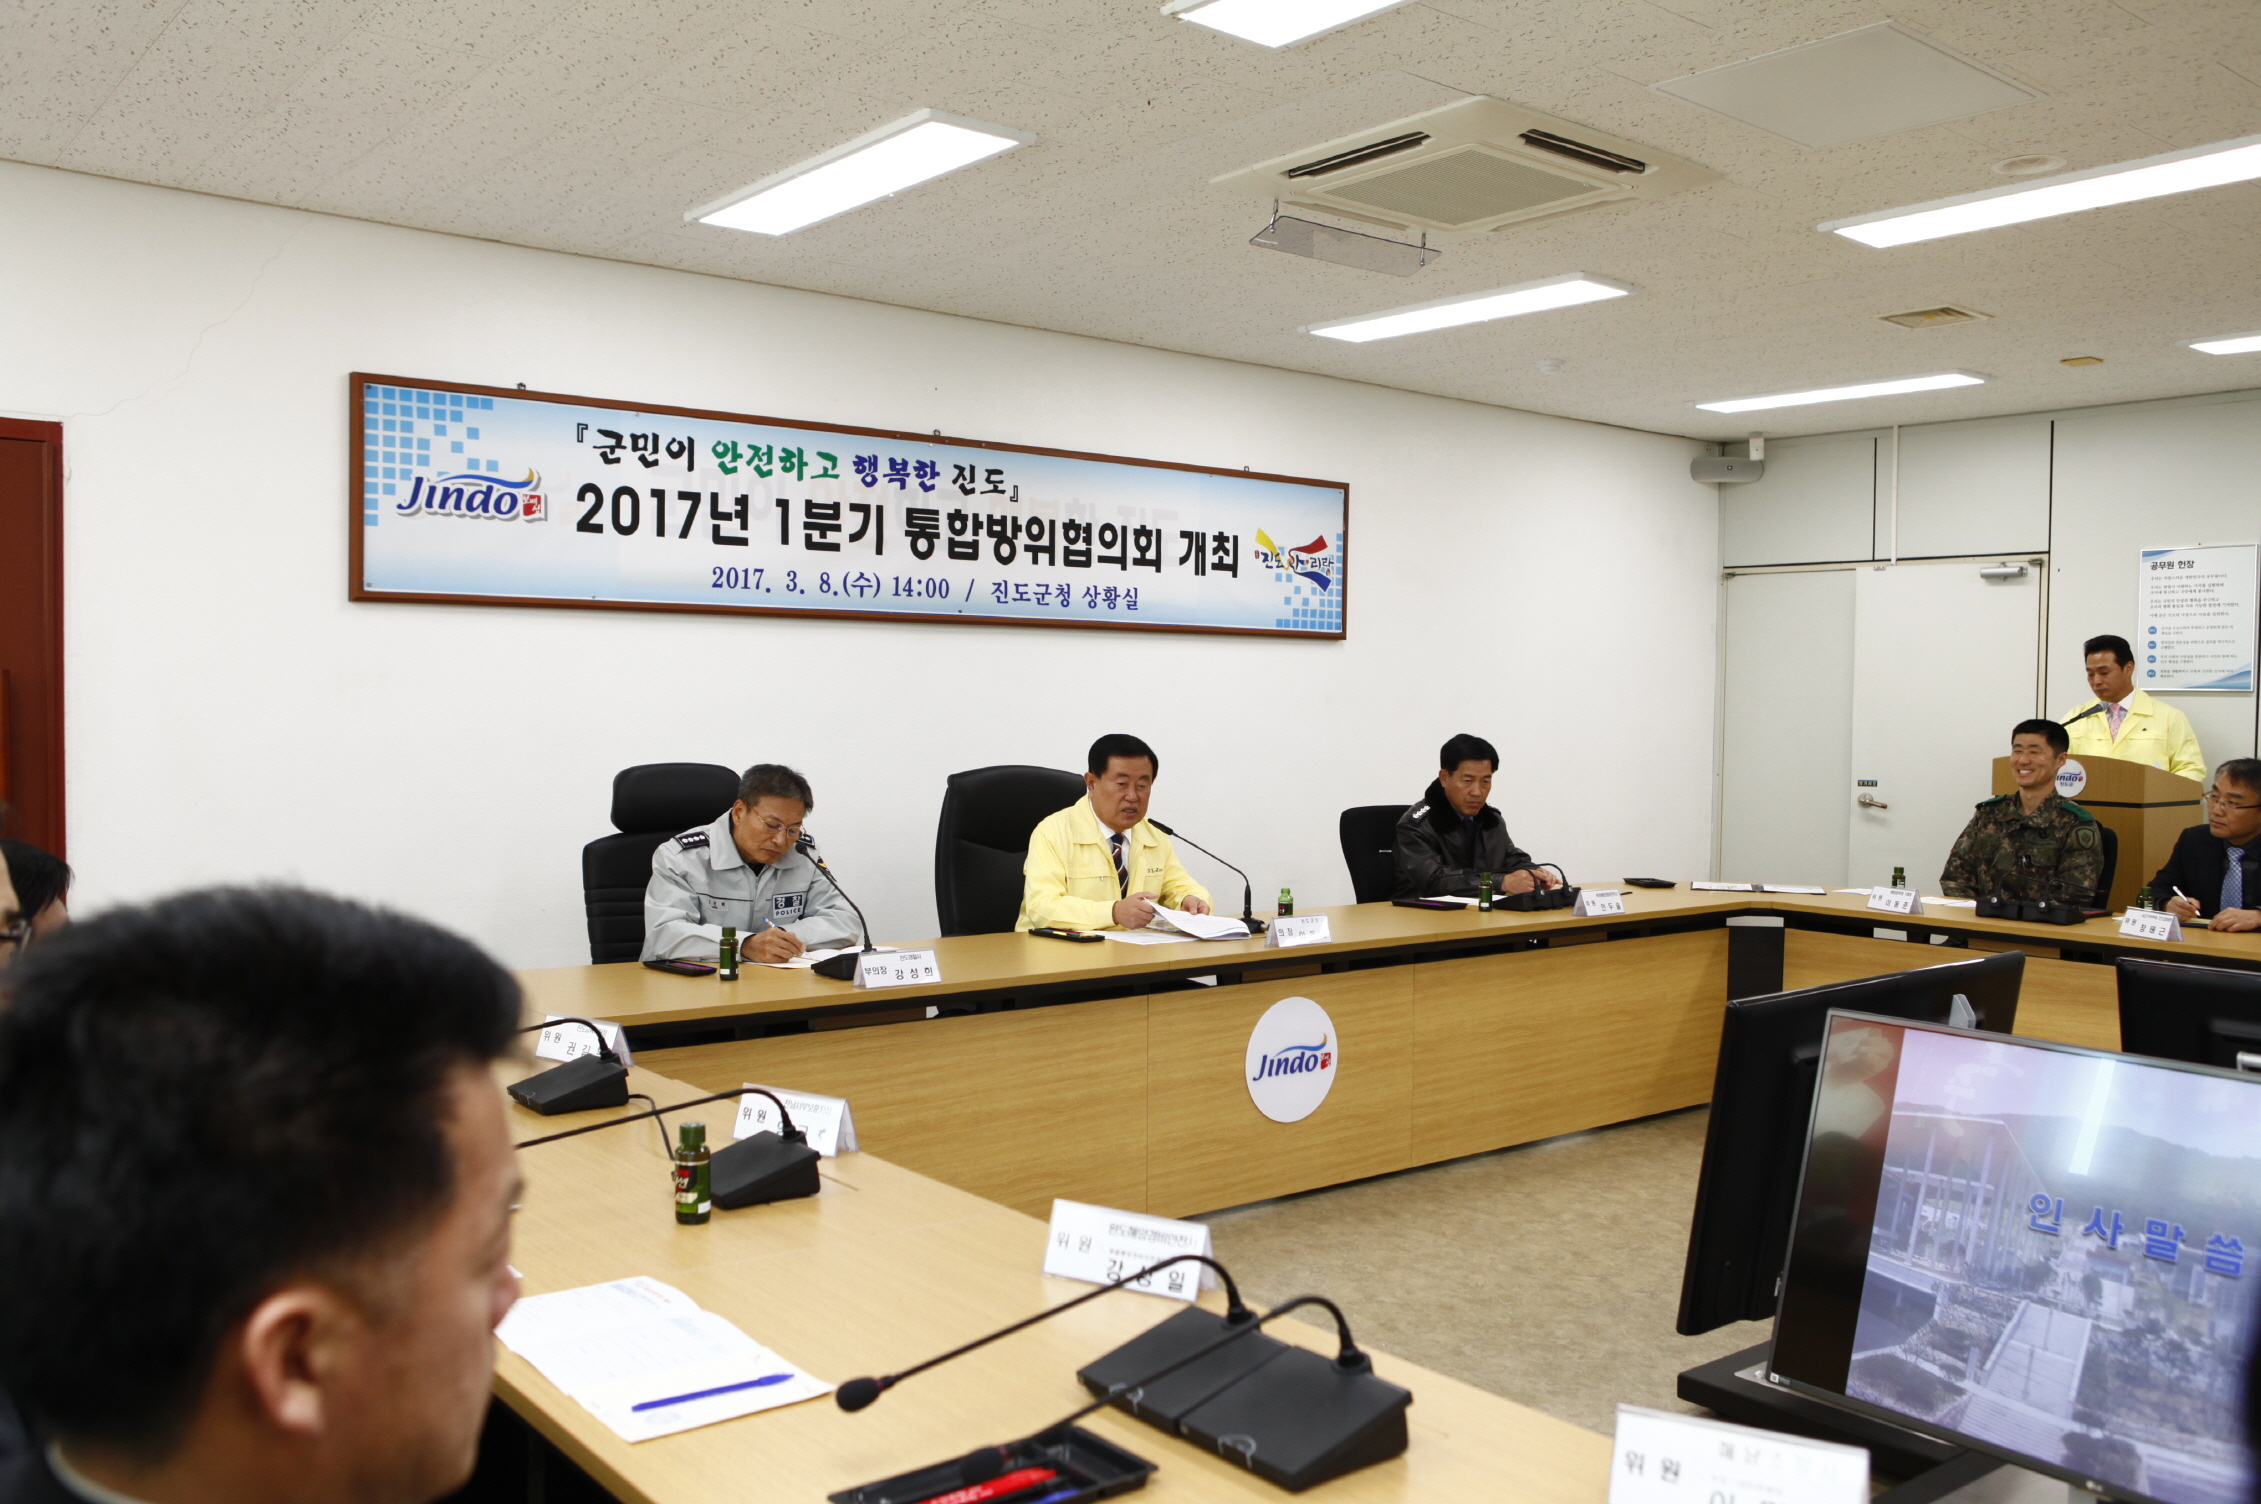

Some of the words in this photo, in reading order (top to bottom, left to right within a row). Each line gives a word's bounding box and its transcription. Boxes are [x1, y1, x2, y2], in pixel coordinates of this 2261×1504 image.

[711, 440, 840, 482] 안전하고
[852, 453, 941, 492] 행복한
[396, 476, 519, 516] Jindo
[576, 482, 750, 547] 2017년
[904, 506, 1162, 573] 통합방위협의회
[1178, 529, 1239, 579] 개최
[2150, 560, 2175, 570] 공무원
[2177, 559, 2195, 570] 헌장
[711, 566, 771, 594] 2017.
[786, 570, 805, 595] 3.
[892, 576, 950, 599] 14:00
[991, 579, 1071, 608] 진도군청
[1082, 585, 1139, 611] 상황실
[2056, 774, 2078, 782] indo
[775, 907, 802, 917] POLICE
[864, 965, 887, 976] 부의장
[1252, 1051, 1319, 1082] Jindo
